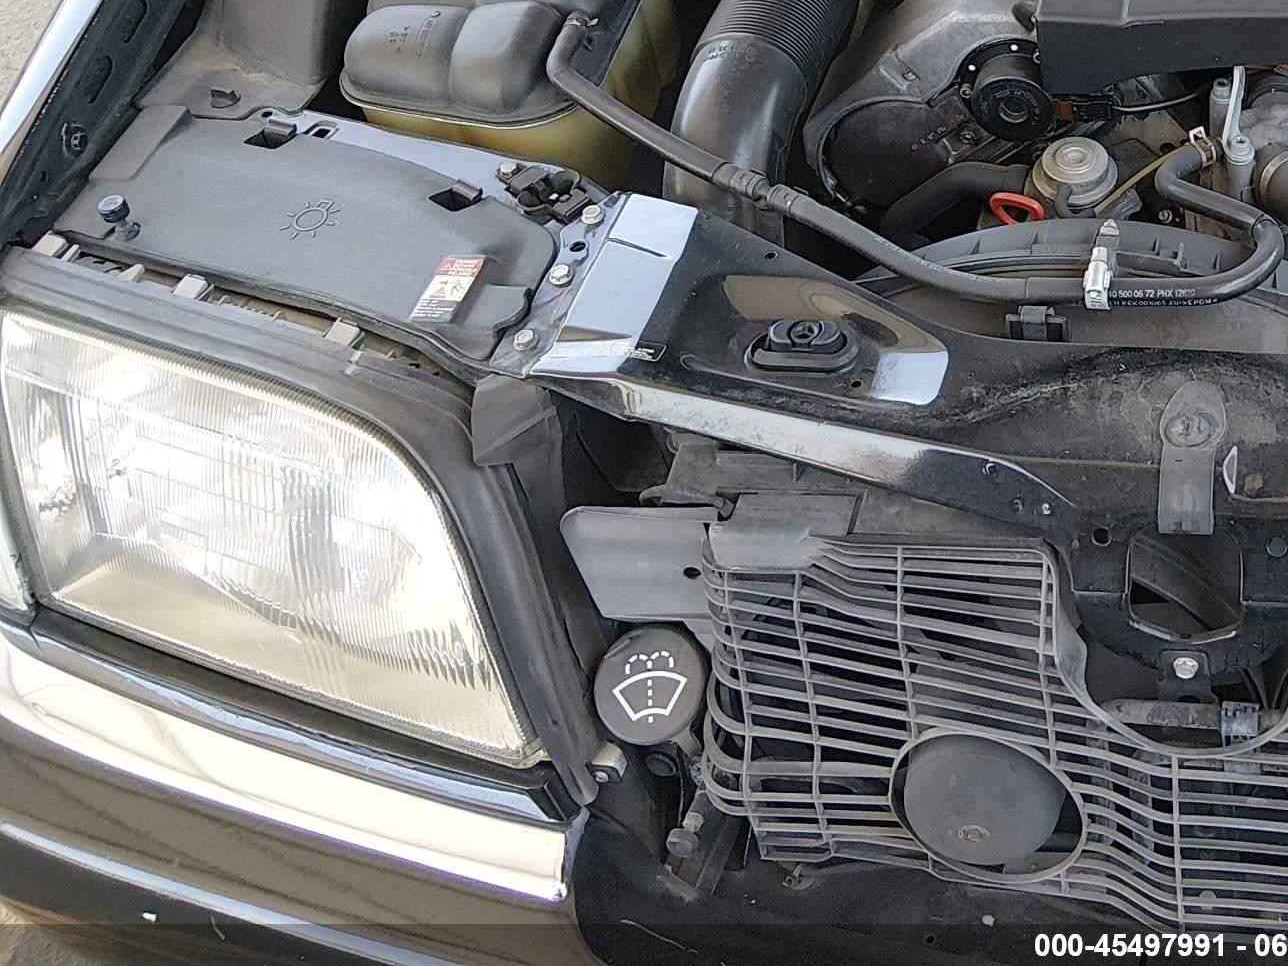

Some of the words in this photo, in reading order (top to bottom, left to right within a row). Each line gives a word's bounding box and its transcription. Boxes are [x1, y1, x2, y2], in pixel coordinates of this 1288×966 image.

[1118, 289, 1133, 299] 500
[1145, 289, 1155, 299] 72
[1156, 289, 1174, 299] PHX
